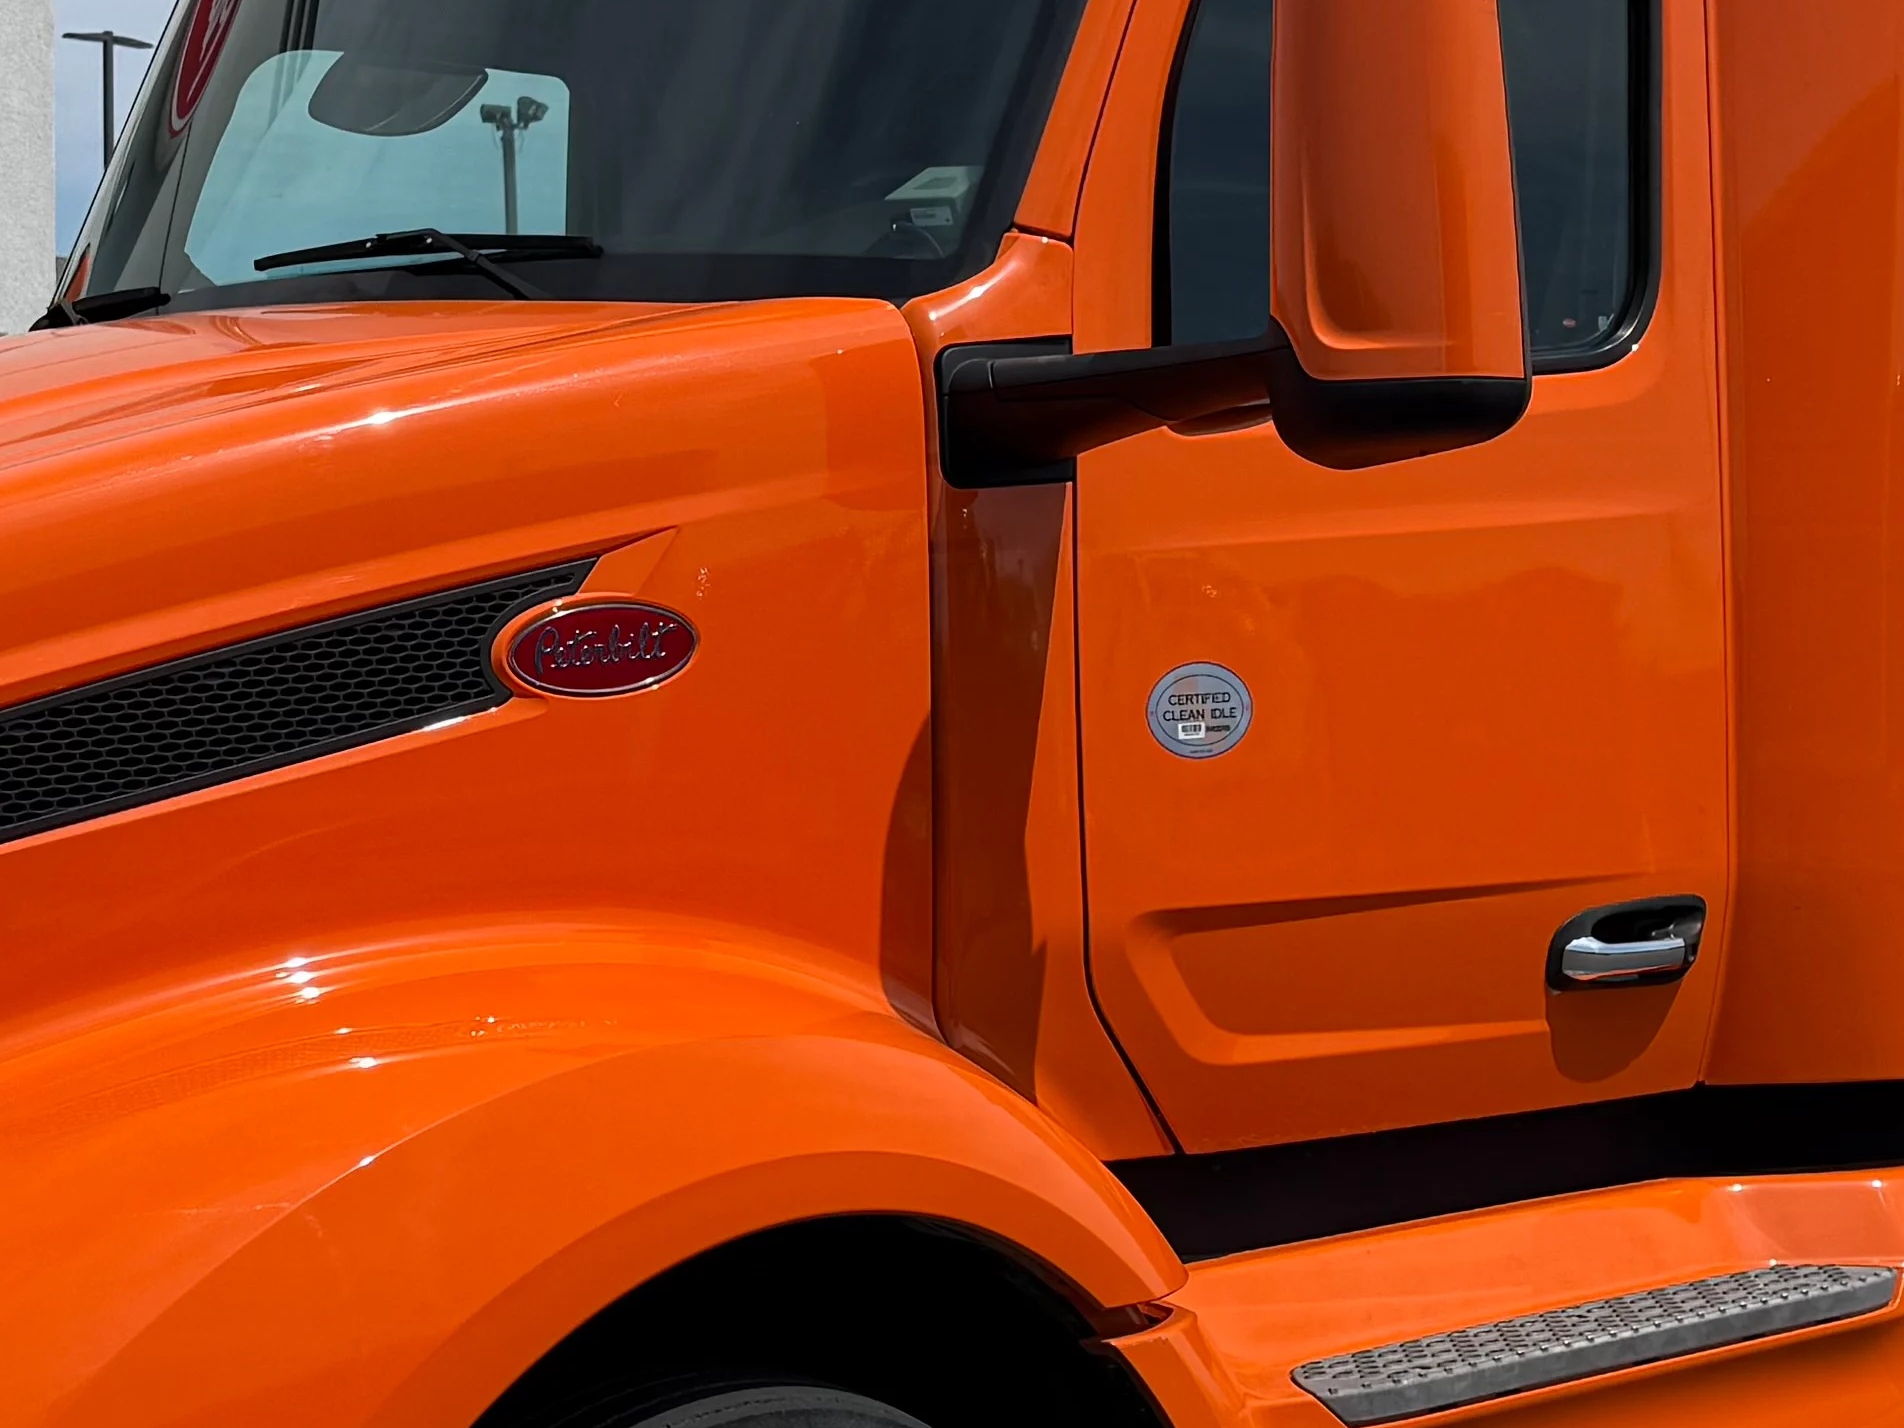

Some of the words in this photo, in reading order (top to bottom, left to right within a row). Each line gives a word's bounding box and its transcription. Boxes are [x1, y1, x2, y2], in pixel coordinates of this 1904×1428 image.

[534, 621, 679, 676] Peterbilt
[1168, 692, 1231, 706] CERTIFIED
[1162, 709, 1205, 721] CLEAN
[1210, 707, 1238, 719] IDLE
